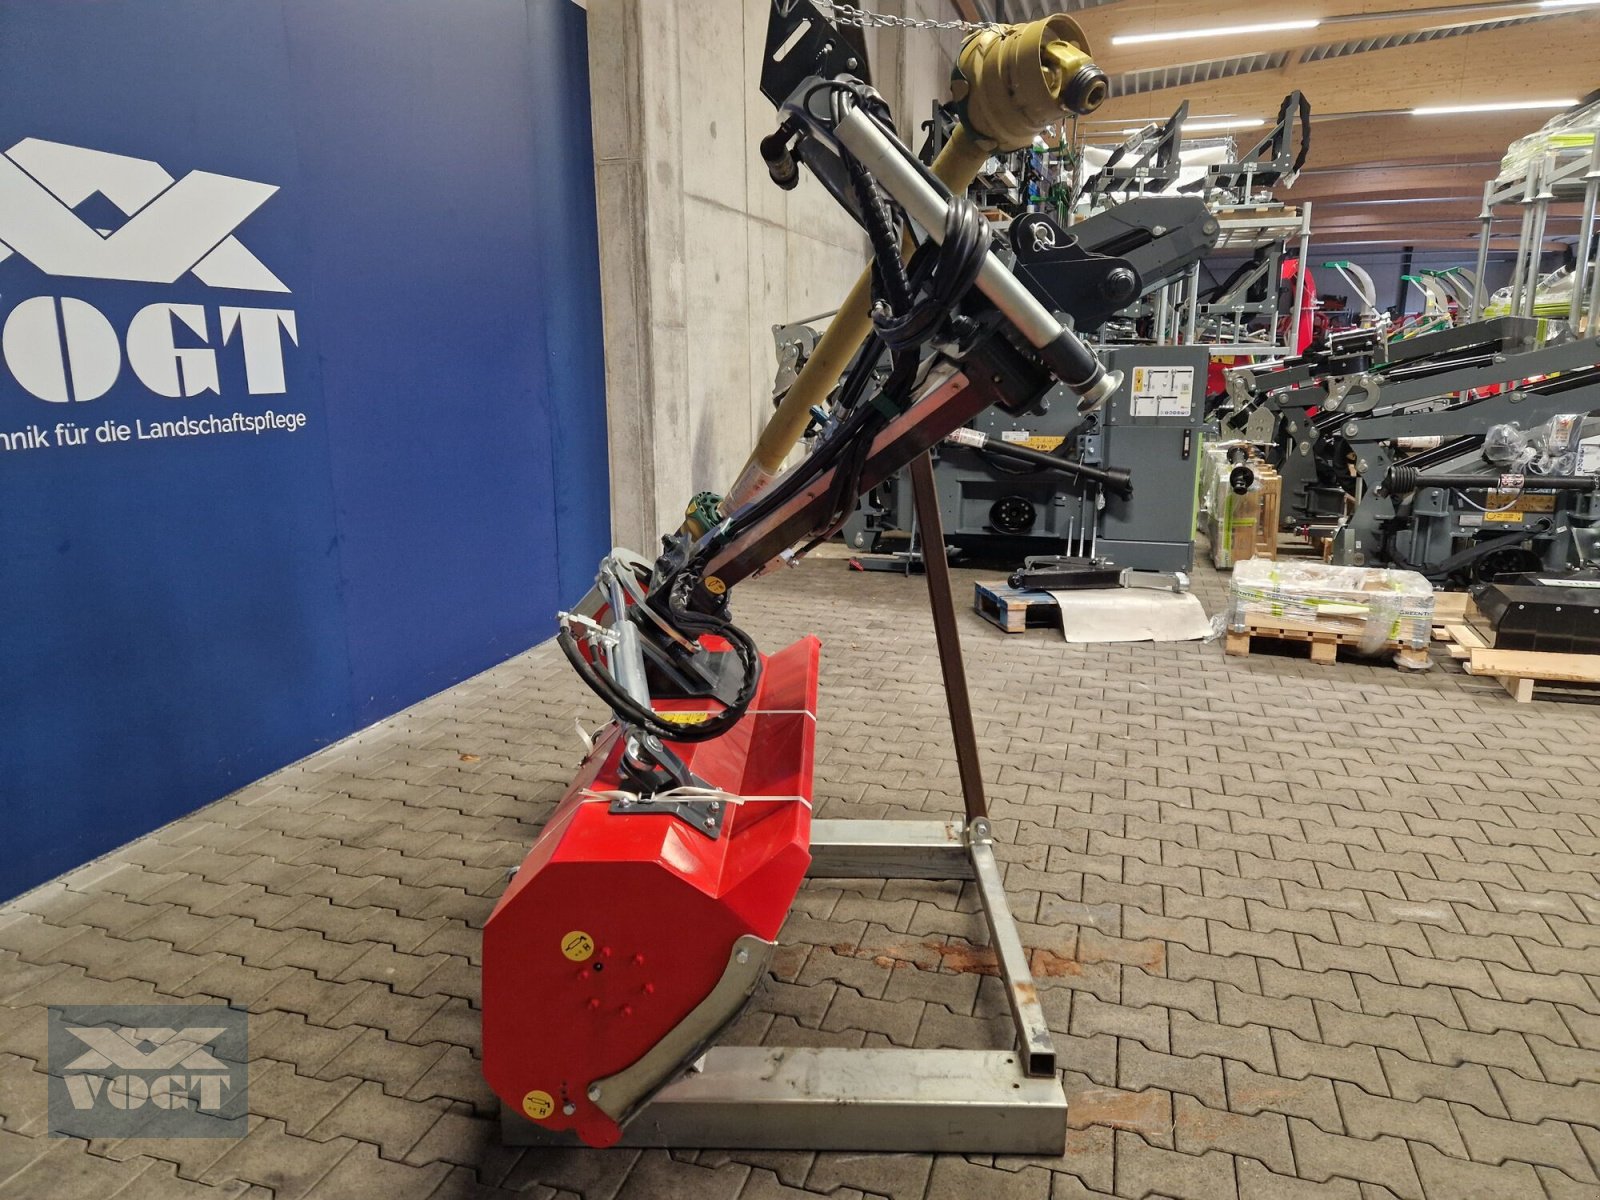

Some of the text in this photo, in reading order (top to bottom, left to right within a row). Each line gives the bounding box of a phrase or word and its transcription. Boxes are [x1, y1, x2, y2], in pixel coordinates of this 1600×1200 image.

[0, 293, 299, 403] OGT
[54, 423, 89, 446] für
[95, 420, 131, 443] die
[136, 410, 307, 440] Landschaftspflege
